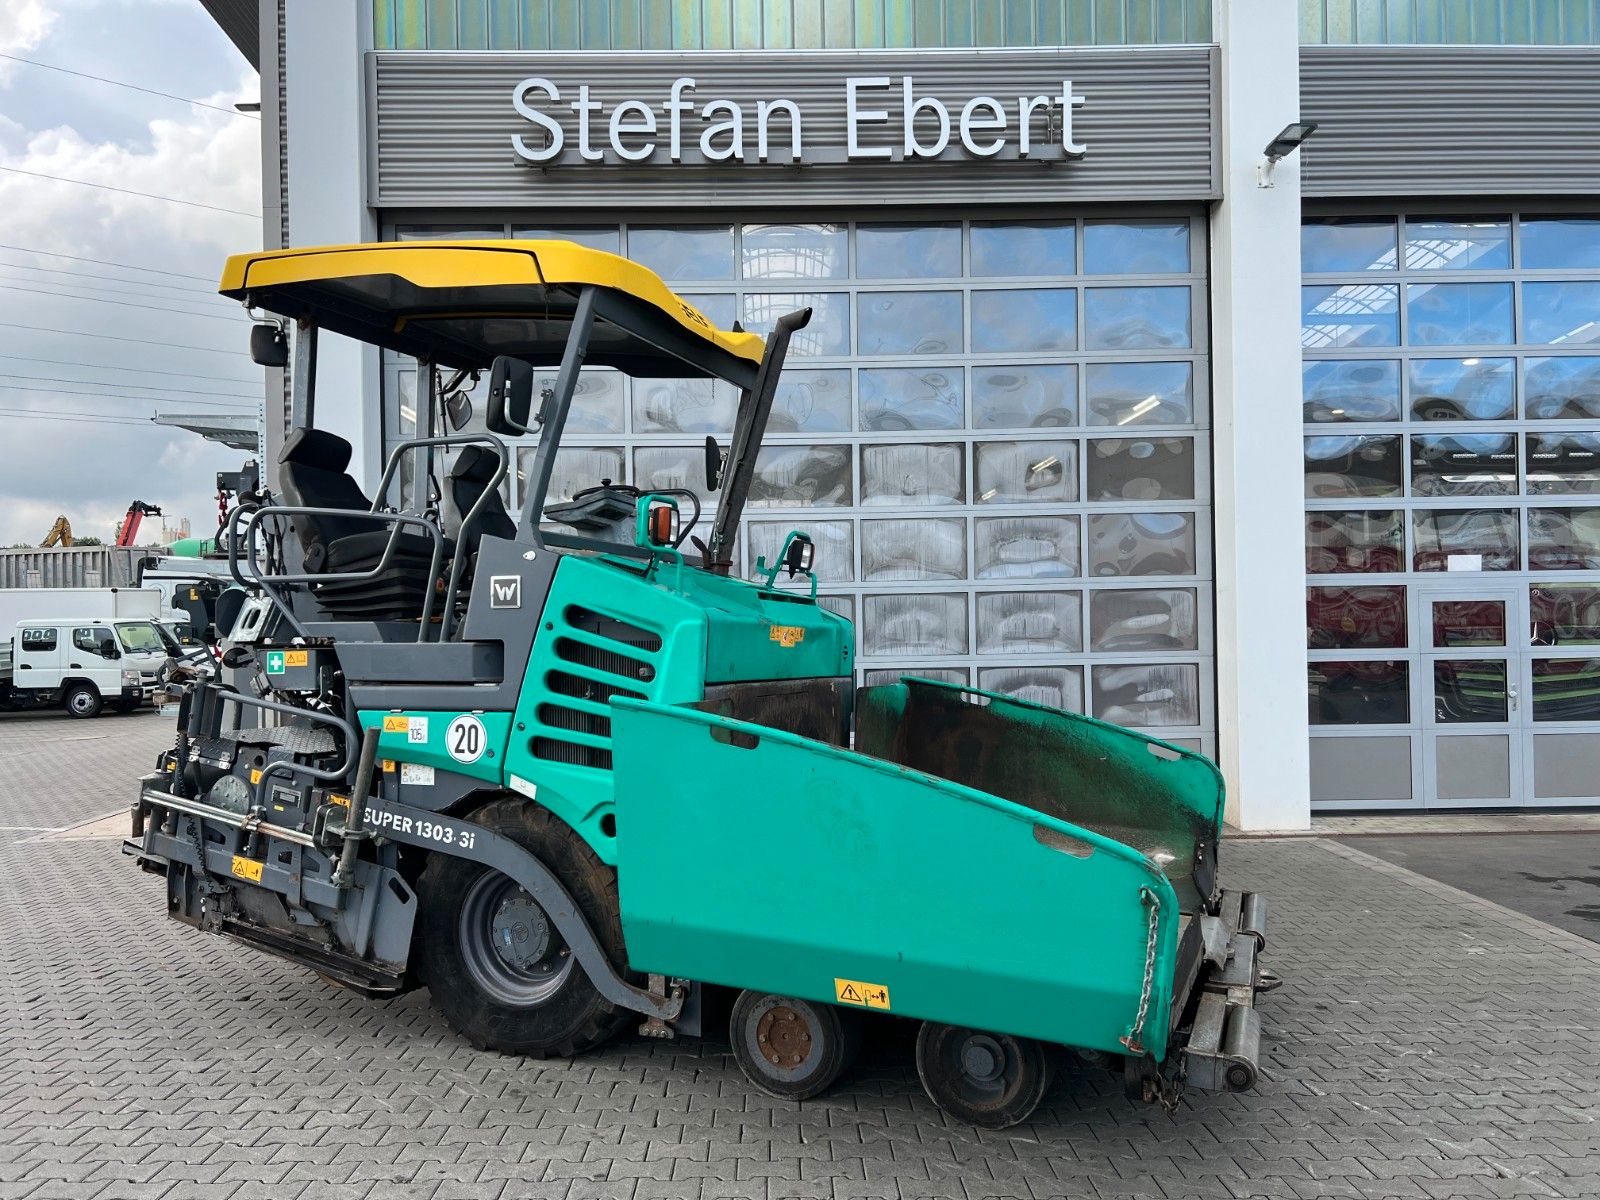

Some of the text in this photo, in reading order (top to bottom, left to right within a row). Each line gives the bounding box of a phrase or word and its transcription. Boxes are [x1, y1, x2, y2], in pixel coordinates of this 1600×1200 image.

[510, 76, 1088, 162] Stefan Ebert
[454, 723, 479, 755] 20
[363, 807, 413, 834] SUPER
